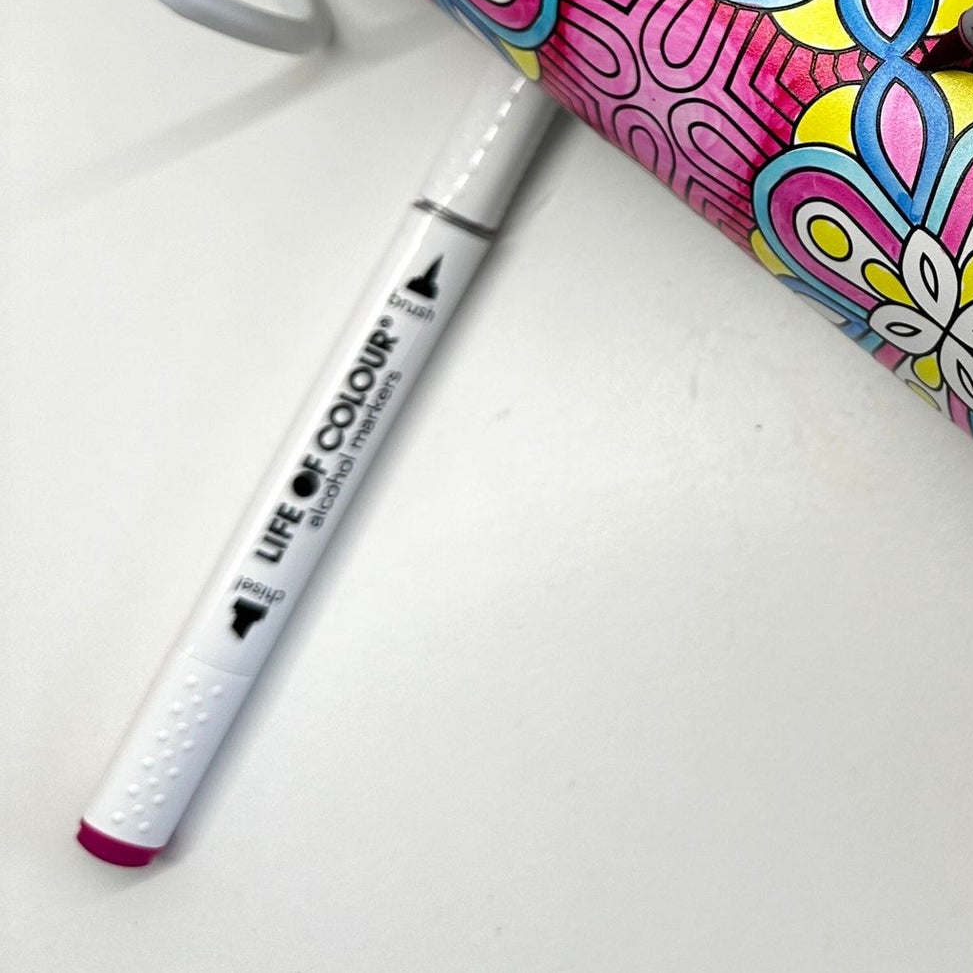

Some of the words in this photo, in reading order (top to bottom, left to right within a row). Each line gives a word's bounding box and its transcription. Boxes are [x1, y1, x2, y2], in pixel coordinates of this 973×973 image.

[388, 290, 437, 323] brush
[307, 452, 355, 530] alcohol
[351, 369, 401, 448] markers
[255, 501, 305, 564] LIFE
[292, 452, 328, 498] OF
